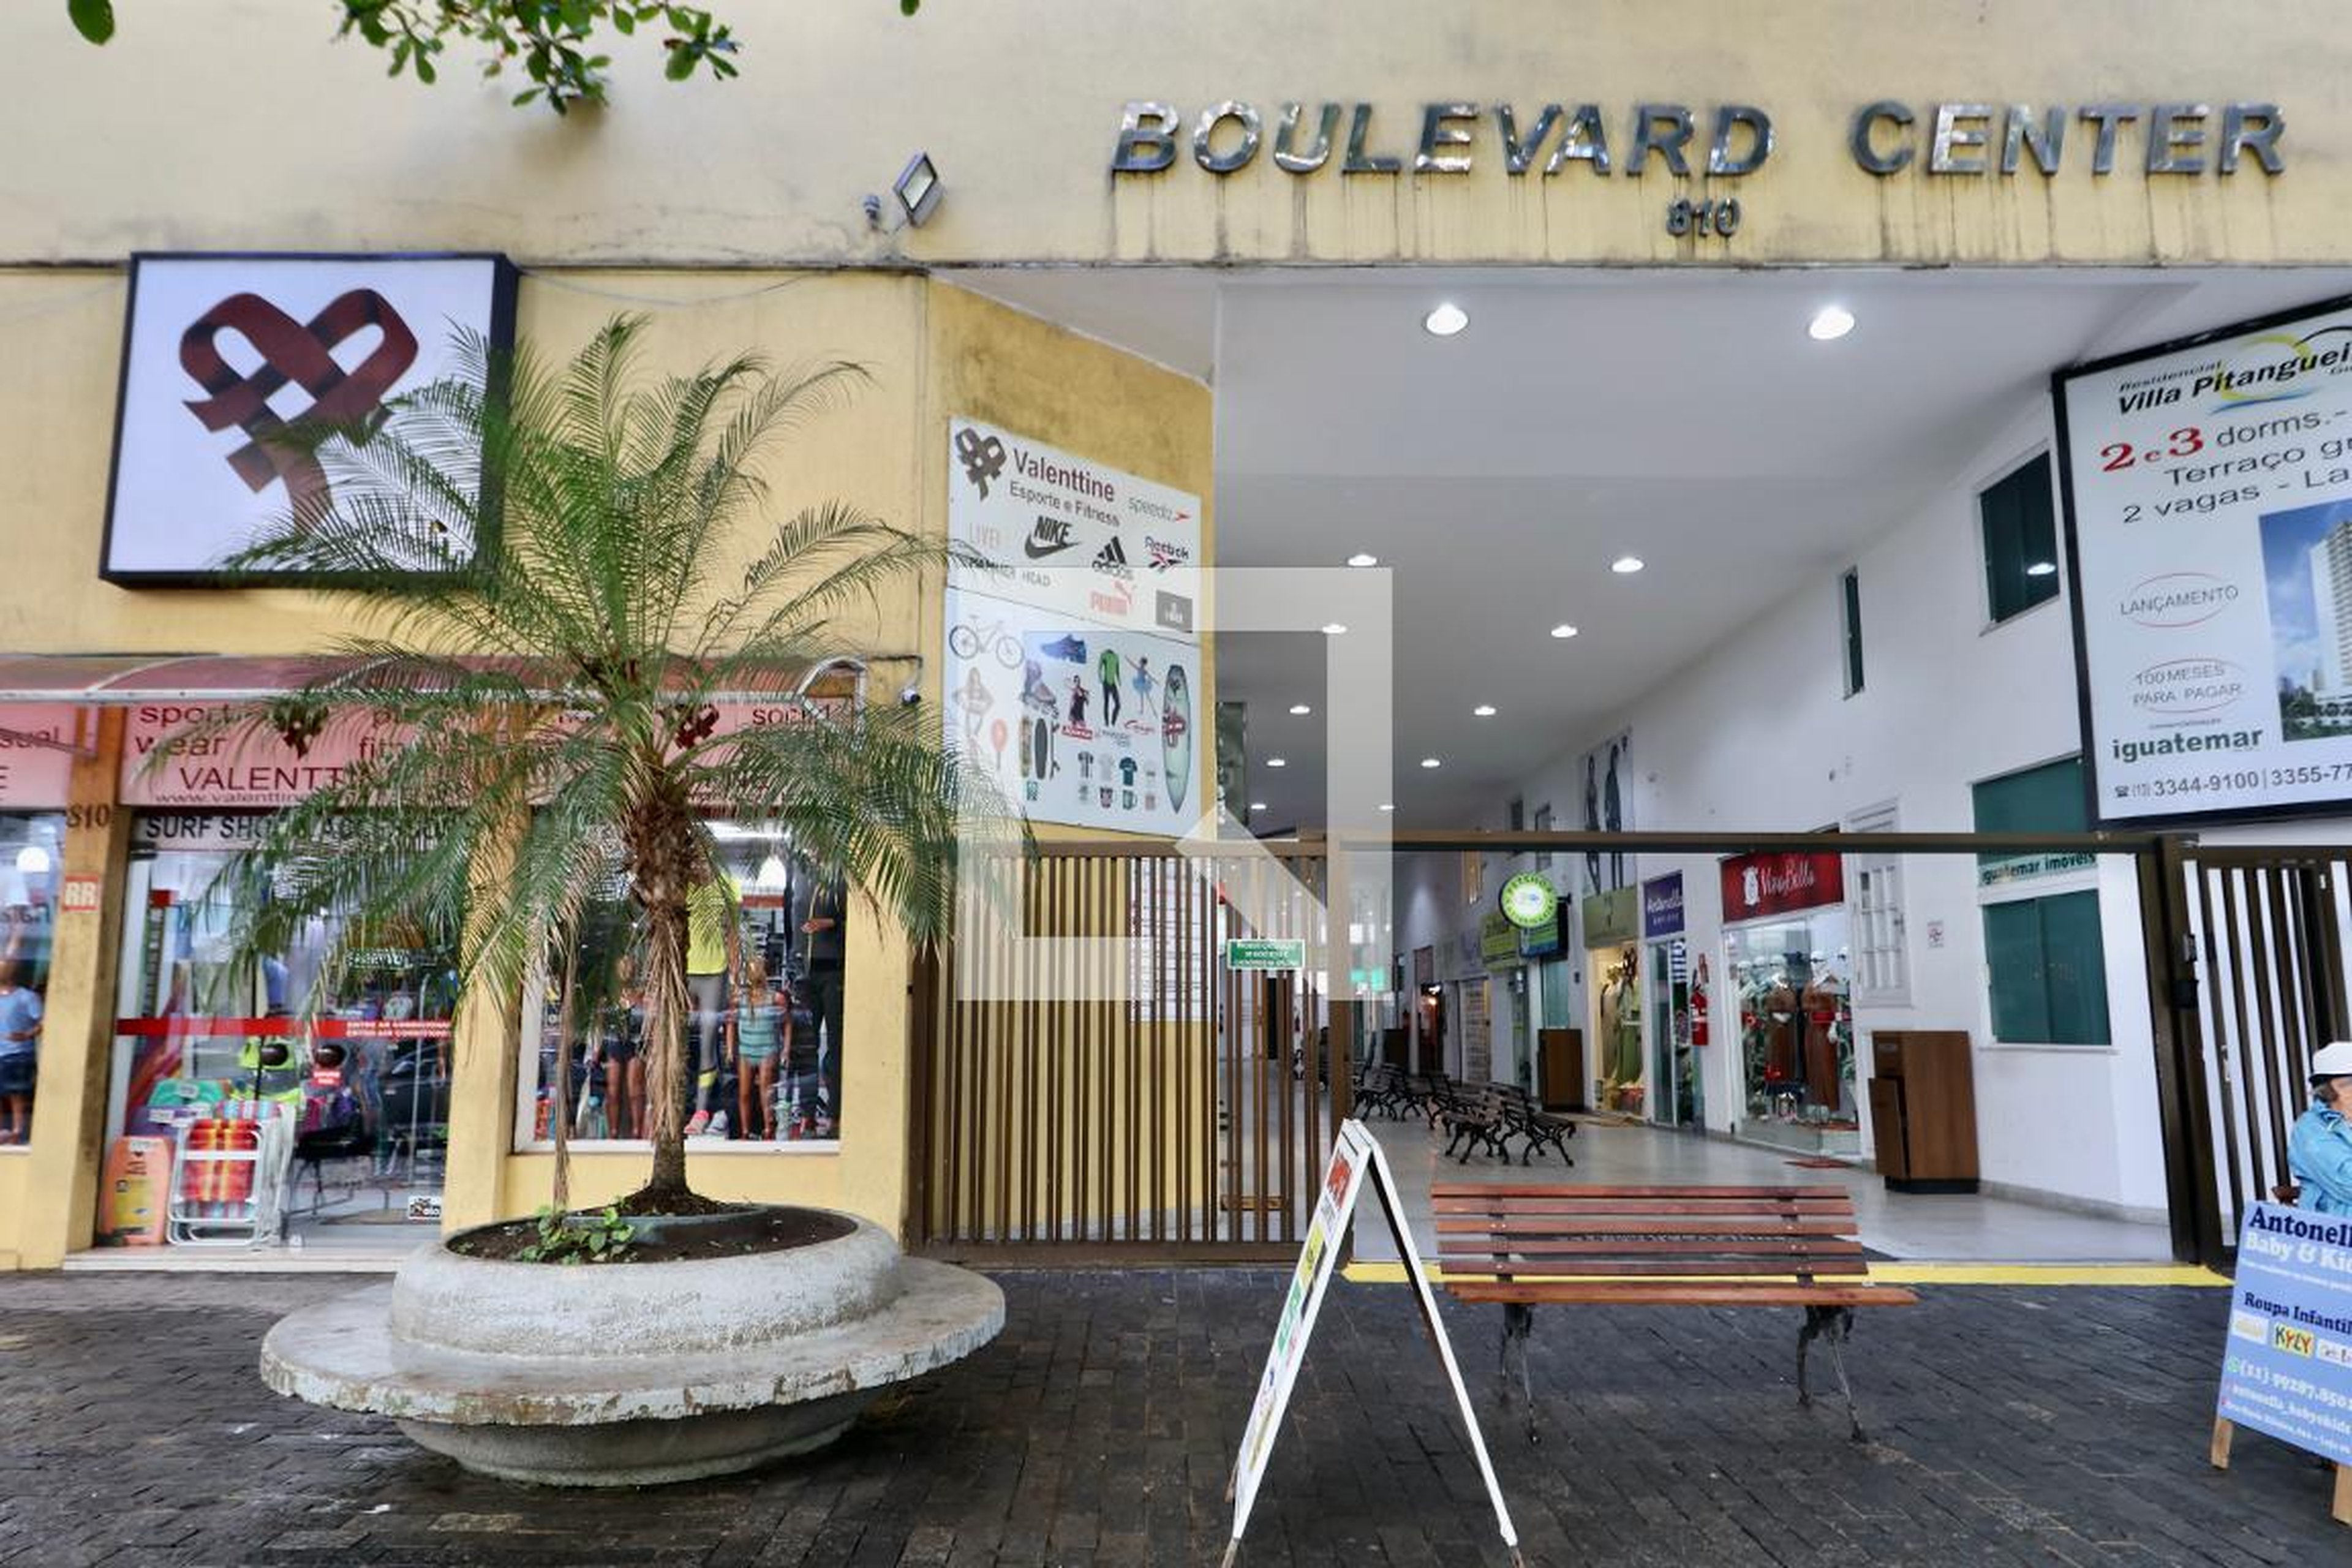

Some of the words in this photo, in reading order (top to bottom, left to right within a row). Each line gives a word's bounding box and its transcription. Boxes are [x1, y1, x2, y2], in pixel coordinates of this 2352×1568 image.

[1111, 99, 1775, 176] BOULEVARD
[1848, 100, 2288, 177] CENTER
[1666, 197, 1741, 238] 810
[2119, 360, 2222, 393] Residencial
[2117, 386, 2182, 415] Villa
[2100, 442, 2136, 472] 2
[2168, 427, 2205, 457] 3
[1013, 447, 1115, 503] Valenttine
[2164, 449, 2306, 488] Terraço
[1010, 479, 1061, 510] Esporte
[1074, 500, 1120, 527] Fitness
[2122, 505, 2141, 524] 2
[2154, 484, 2261, 519] vagas
[1034, 514, 1073, 547] NIKE
[2120, 586, 2239, 616] LANÇAMENTO
[2133, 690, 2177, 706] PARA
[2184, 683, 2241, 700] PAGAR
[2111, 727, 2264, 763] iguatemar
[2154, 770, 2260, 798] 3344-9100
[146, 816, 213, 839] SURF
[219, 816, 279, 839] SHO
[2246, 1231, 2293, 1262] Baby
[2297, 1242, 2316, 1264] &
[2244, 1292, 2290, 1317] Roupa
[2275, 1325, 2312, 1354] KYLY
